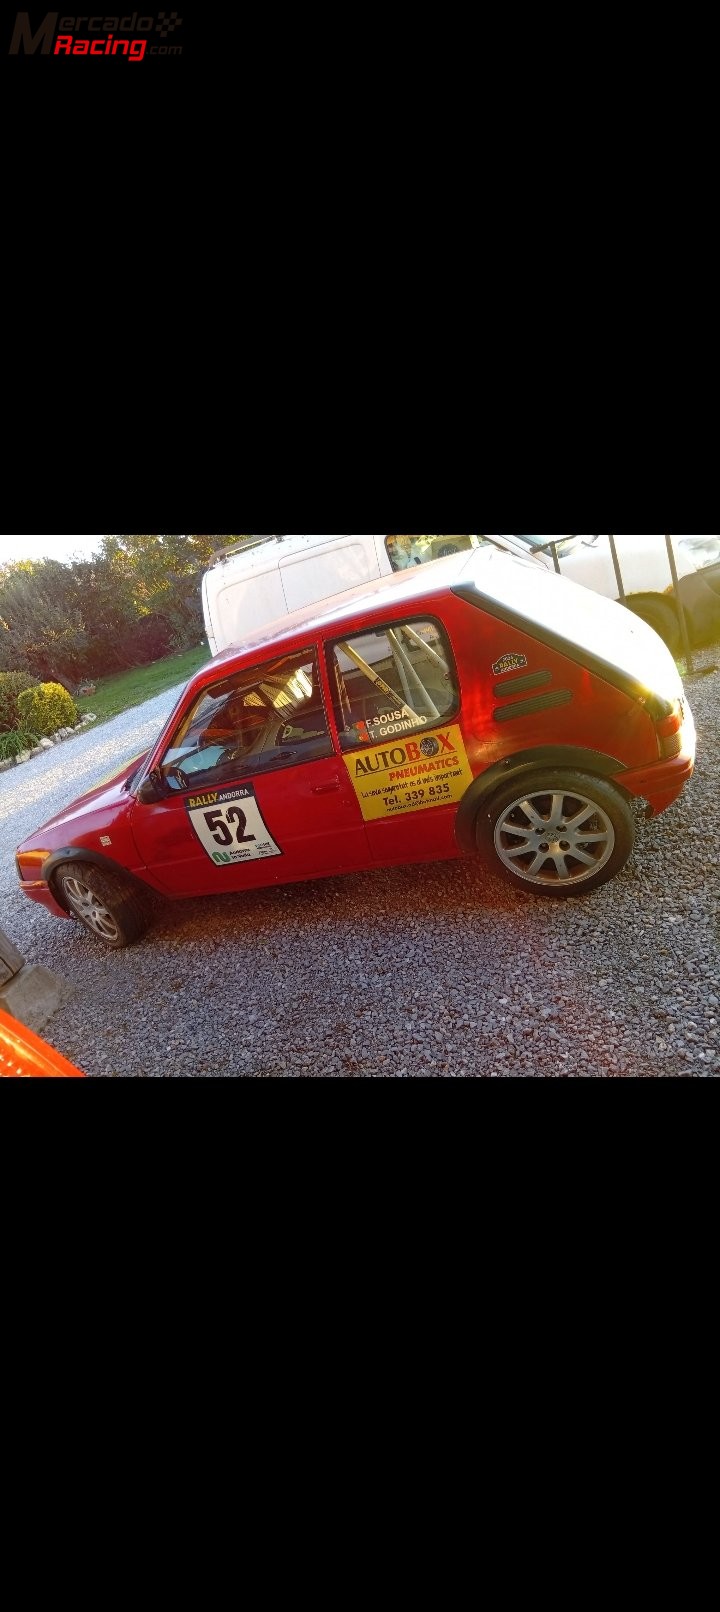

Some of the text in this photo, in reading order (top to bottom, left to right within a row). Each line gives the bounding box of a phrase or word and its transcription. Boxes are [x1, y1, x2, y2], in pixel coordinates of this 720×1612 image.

[379, 715, 427, 736] GODINHO
[388, 756, 460, 781] PNEUMATICS
[189, 788, 250, 807] RALLY ANDORRA
[383, 783, 450, 806] Tel. 339 835
[203, 806, 256, 846] 52
